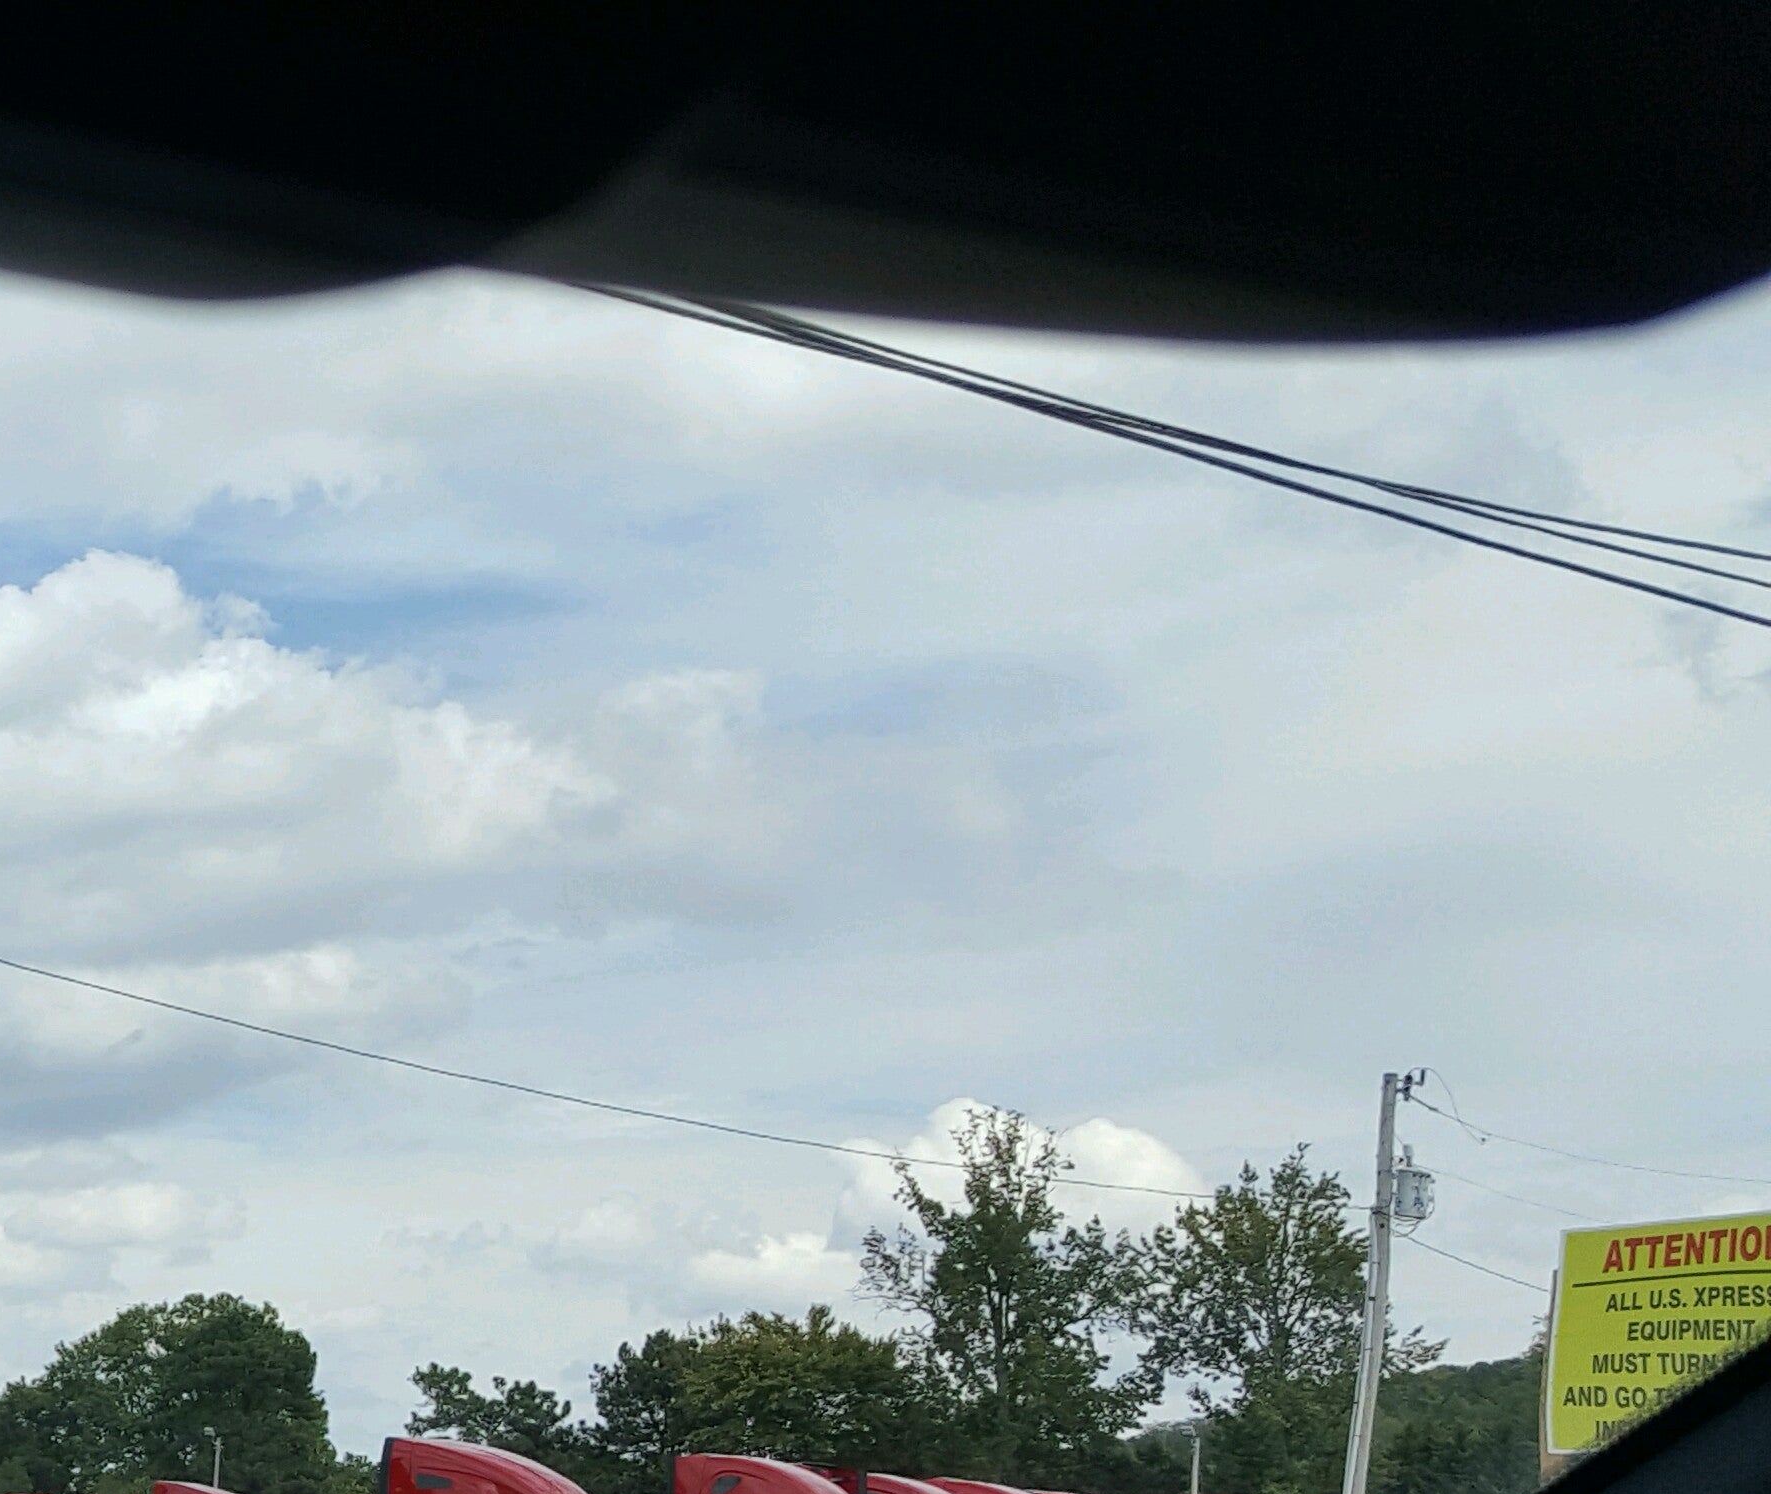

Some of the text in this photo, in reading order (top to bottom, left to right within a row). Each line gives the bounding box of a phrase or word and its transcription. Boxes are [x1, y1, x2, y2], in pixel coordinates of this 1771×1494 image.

[1605, 1292, 1643, 1312] ALL
[1649, 1288, 1687, 1309] U.S.
[1627, 1319, 1756, 1342] EQUIPMENT
[1592, 1353, 1651, 1374] MUST
[1657, 1353, 1715, 1375] TURN
[1563, 1387, 1607, 1407] AND
[1615, 1387, 1647, 1409] GO
